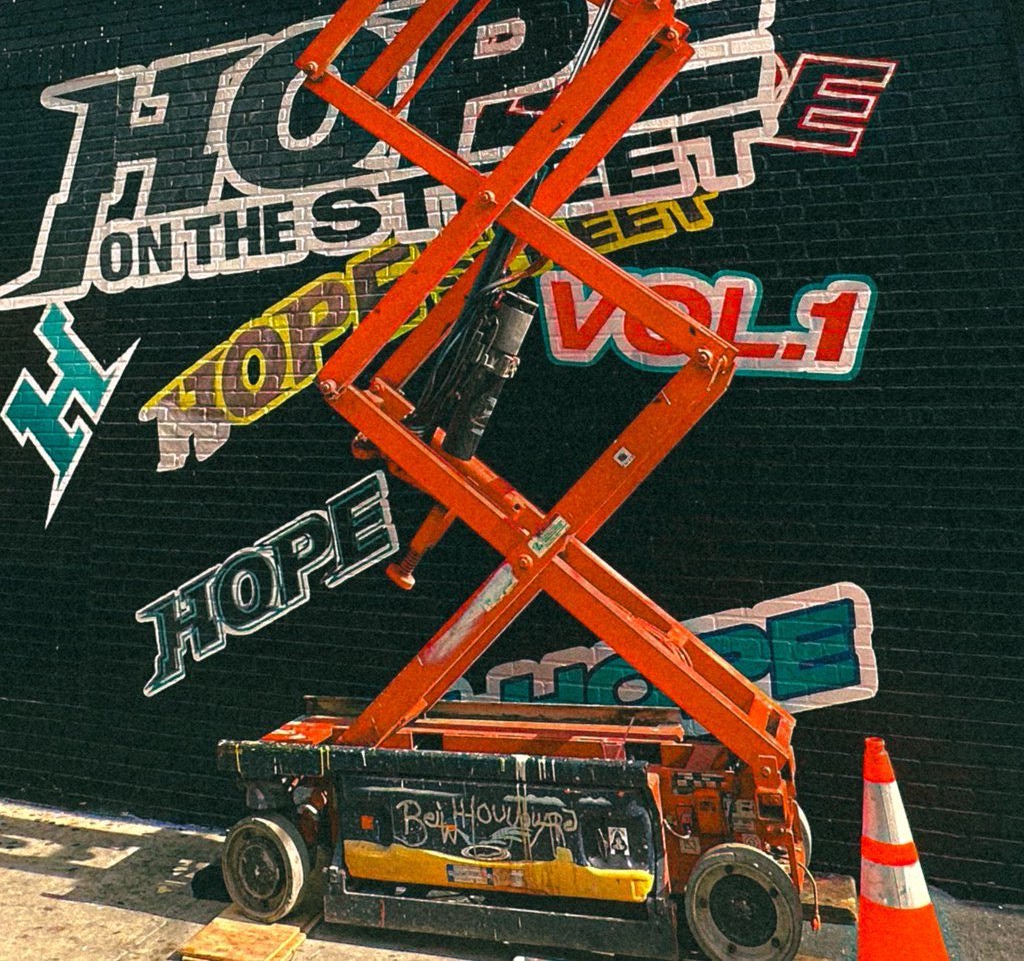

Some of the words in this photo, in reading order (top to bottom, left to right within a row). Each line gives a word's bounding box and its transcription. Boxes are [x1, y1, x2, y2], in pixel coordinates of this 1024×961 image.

[98, 225, 175, 282] ON
[182, 199, 297, 269] THE
[311, 112, 763, 245] STEET
[543, 274, 869, 371] VOL.1
[135, 470, 400, 697] HOPE
